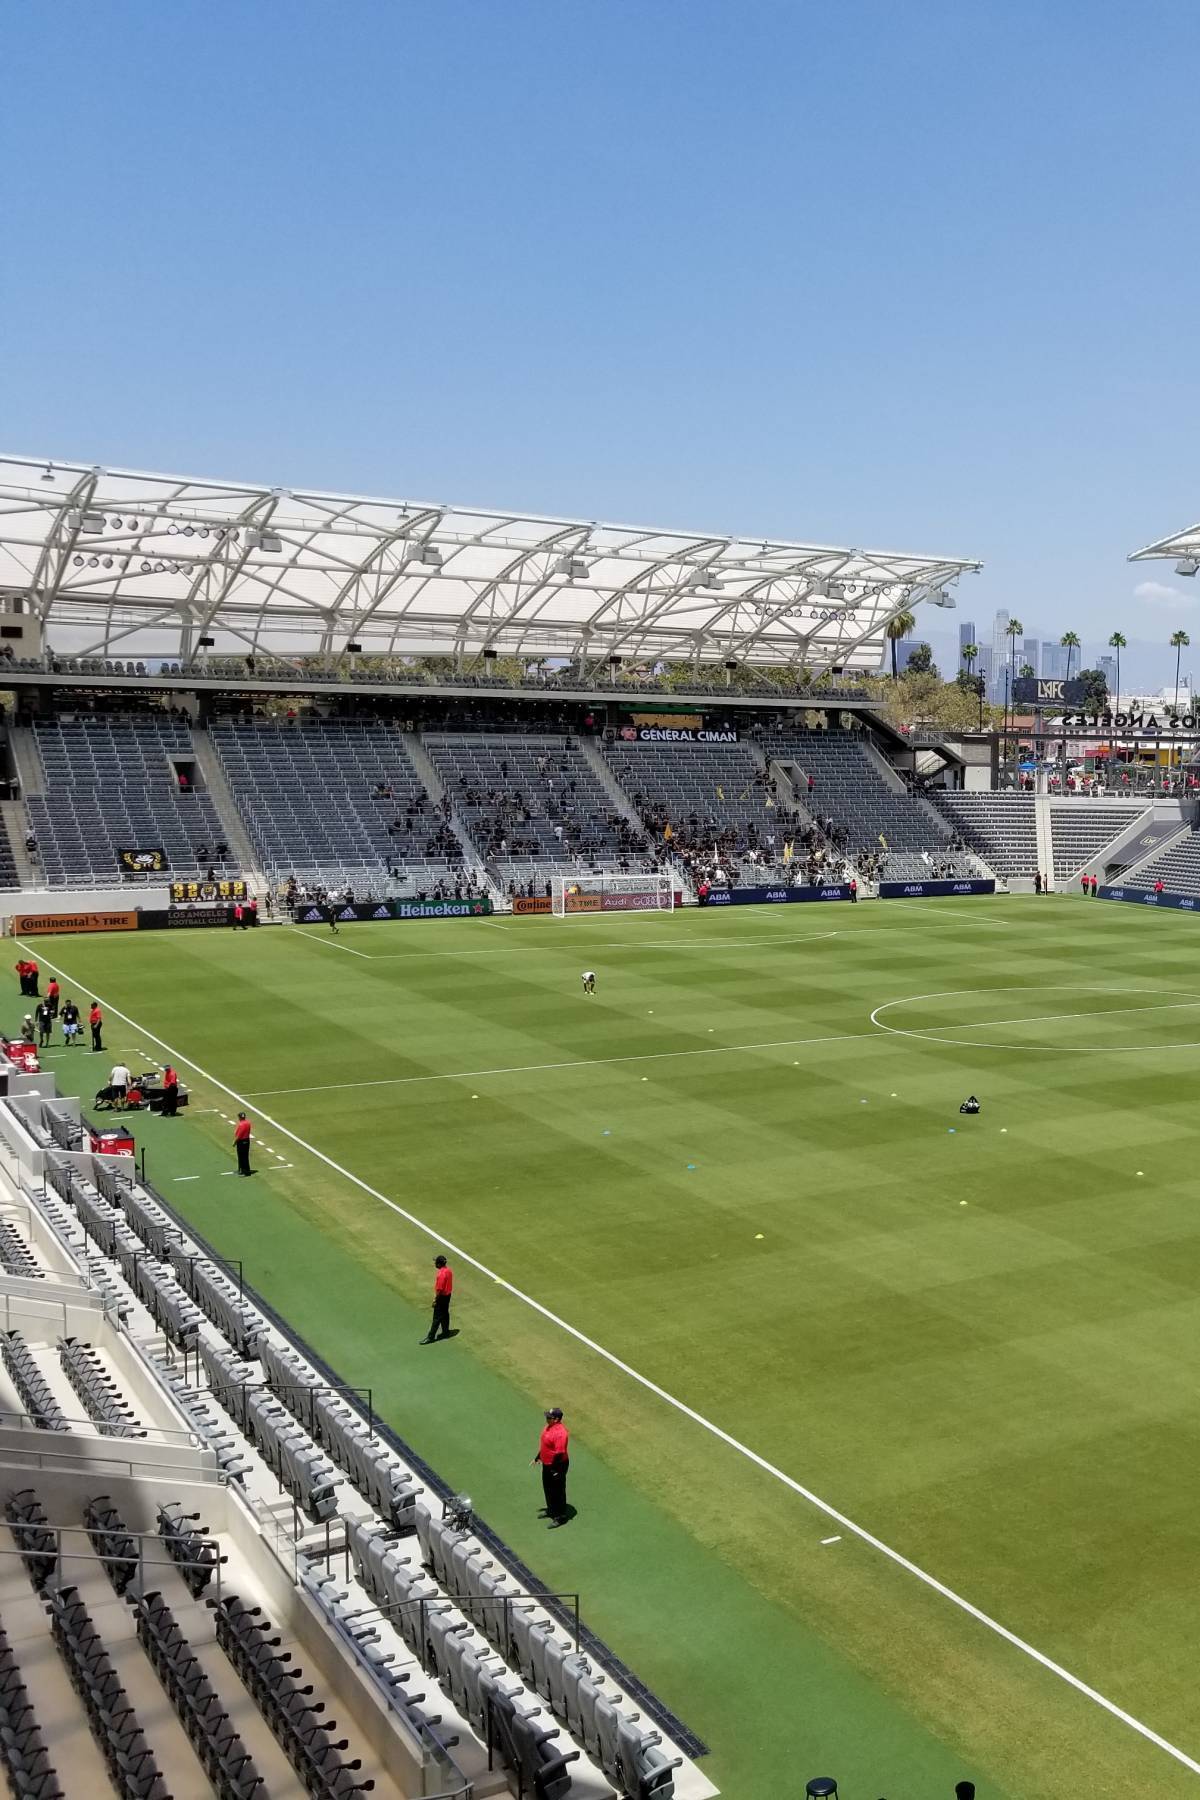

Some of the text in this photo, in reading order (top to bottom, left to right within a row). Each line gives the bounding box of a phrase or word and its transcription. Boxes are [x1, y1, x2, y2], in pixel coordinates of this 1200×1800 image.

[1037, 680, 1065, 699] LAFC
[697, 730, 737, 742] CIMAN
[709, 893, 731, 901] ABM
[766, 891, 787, 899] ABM
[820, 889, 841, 897] ABM
[1110, 889, 1124, 897] ABM
[1143, 893, 1158, 901] ABM
[604, 897, 627, 906] Audi
[1179, 898, 1195, 906] ABM
[168, 909, 228, 919] LOS ANGELES
[400, 903, 470, 917] Heineken
[21, 916, 129, 931] Continental TIRE
[168, 918, 206, 926] FOOTBALL
